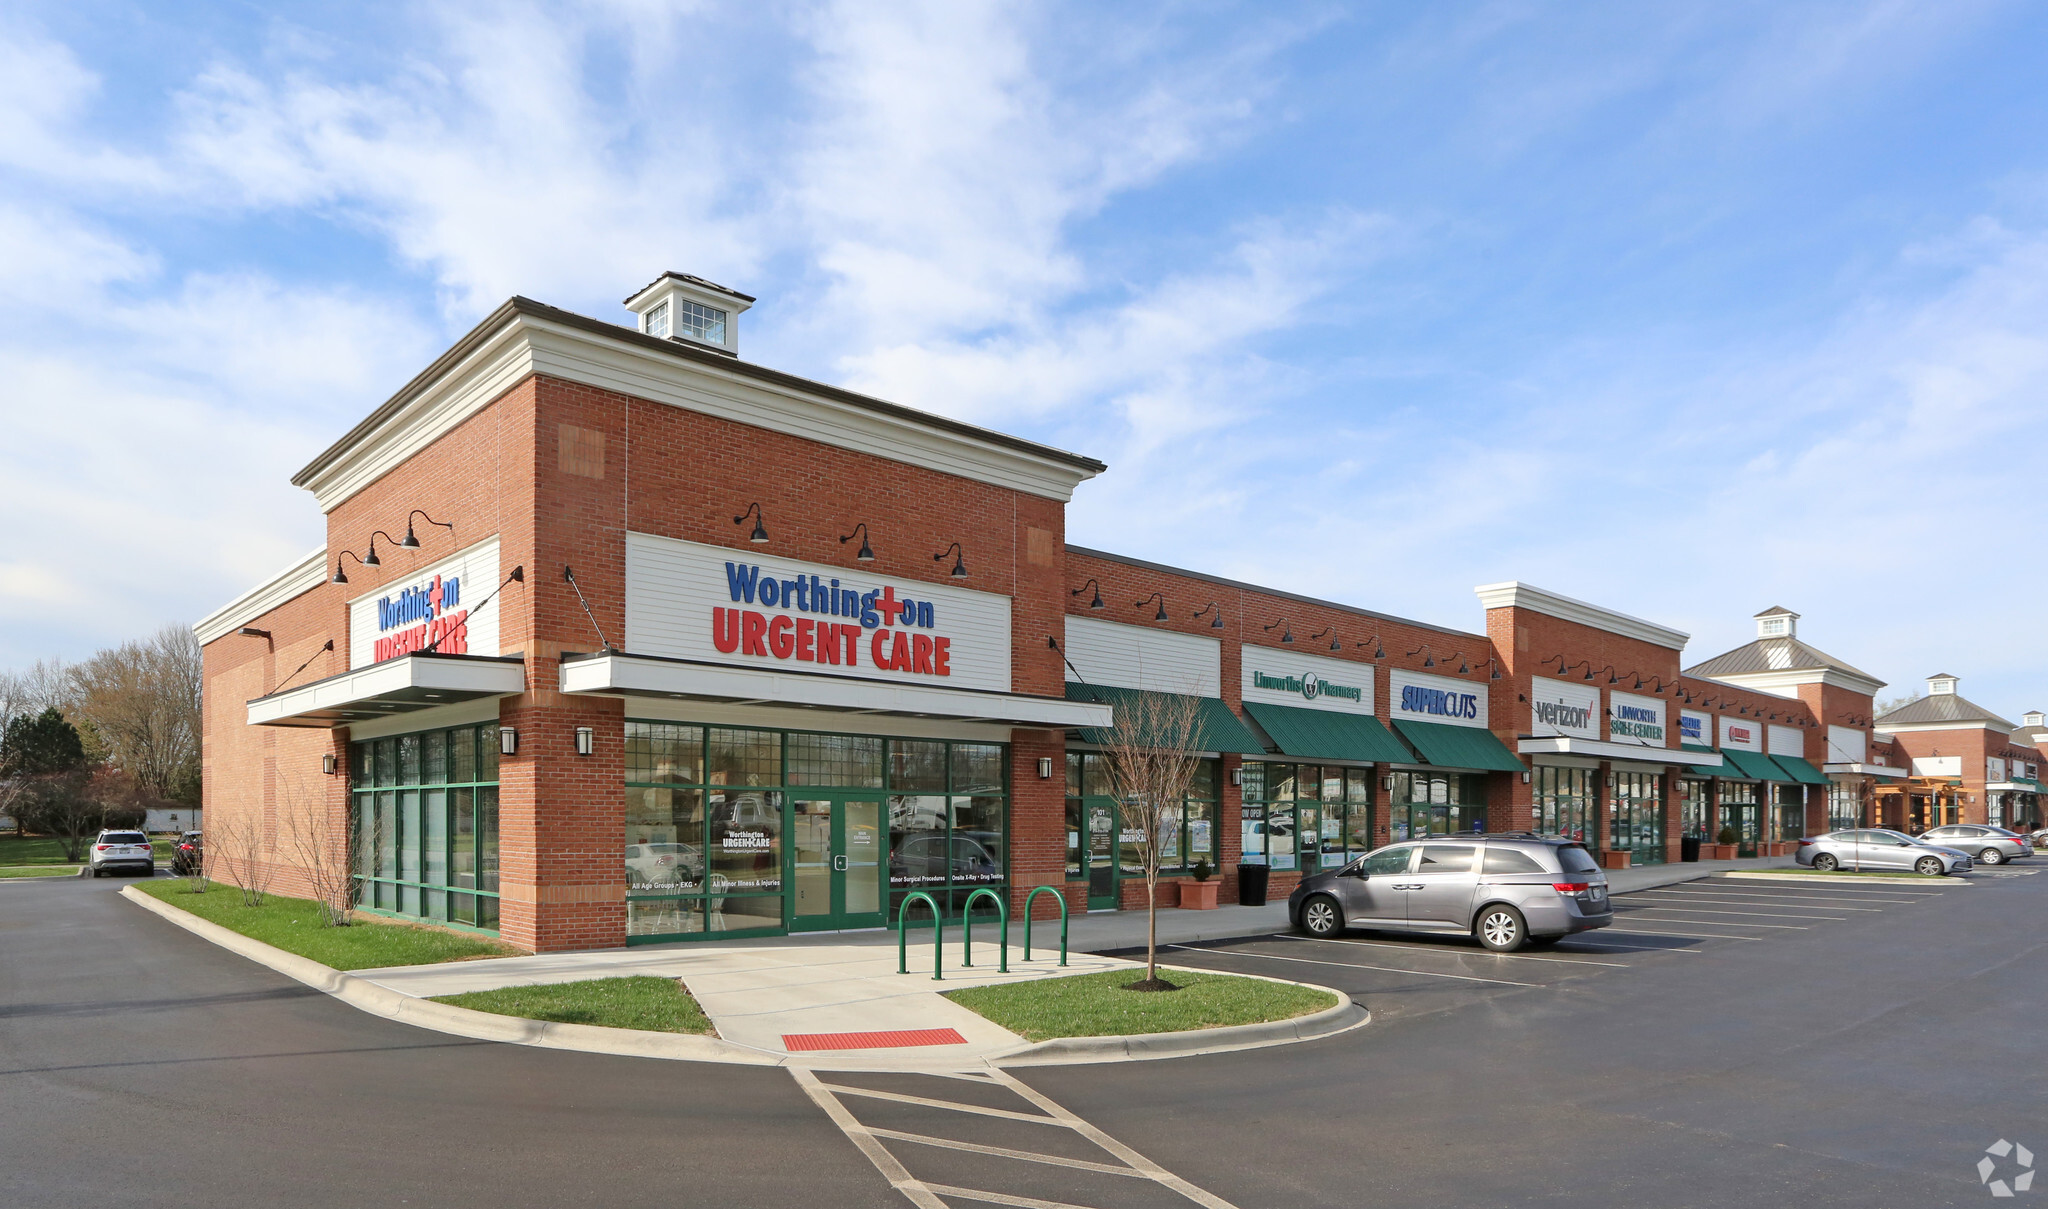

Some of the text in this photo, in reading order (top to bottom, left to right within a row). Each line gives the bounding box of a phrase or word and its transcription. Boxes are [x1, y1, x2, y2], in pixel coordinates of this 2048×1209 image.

[377, 574, 460, 632] Worthington
[725, 562, 935, 628] Worthington
[373, 609, 468, 663] URGENT CARE
[713, 606, 951, 676] URGENT CARE
[1254, 670, 1361, 702] Linworths Pharmacy
[1401, 685, 1477, 719] SUPERCUTS
[1536, 698, 1587, 729] verizon
[1617, 704, 1656, 723] LINWORTH
[1610, 719, 1633, 735] SMILE
[1634, 722, 1663, 740] CENTER
[729, 831, 764, 839] Worthington
[752, 838, 770, 848] CARE
[641, 882, 653, 891] Age
[654, 882, 675, 890] Groups
[738, 879, 755, 887] Illness
[761, 879, 780, 887] Injuries
[903, 876, 921, 884] Surgical
